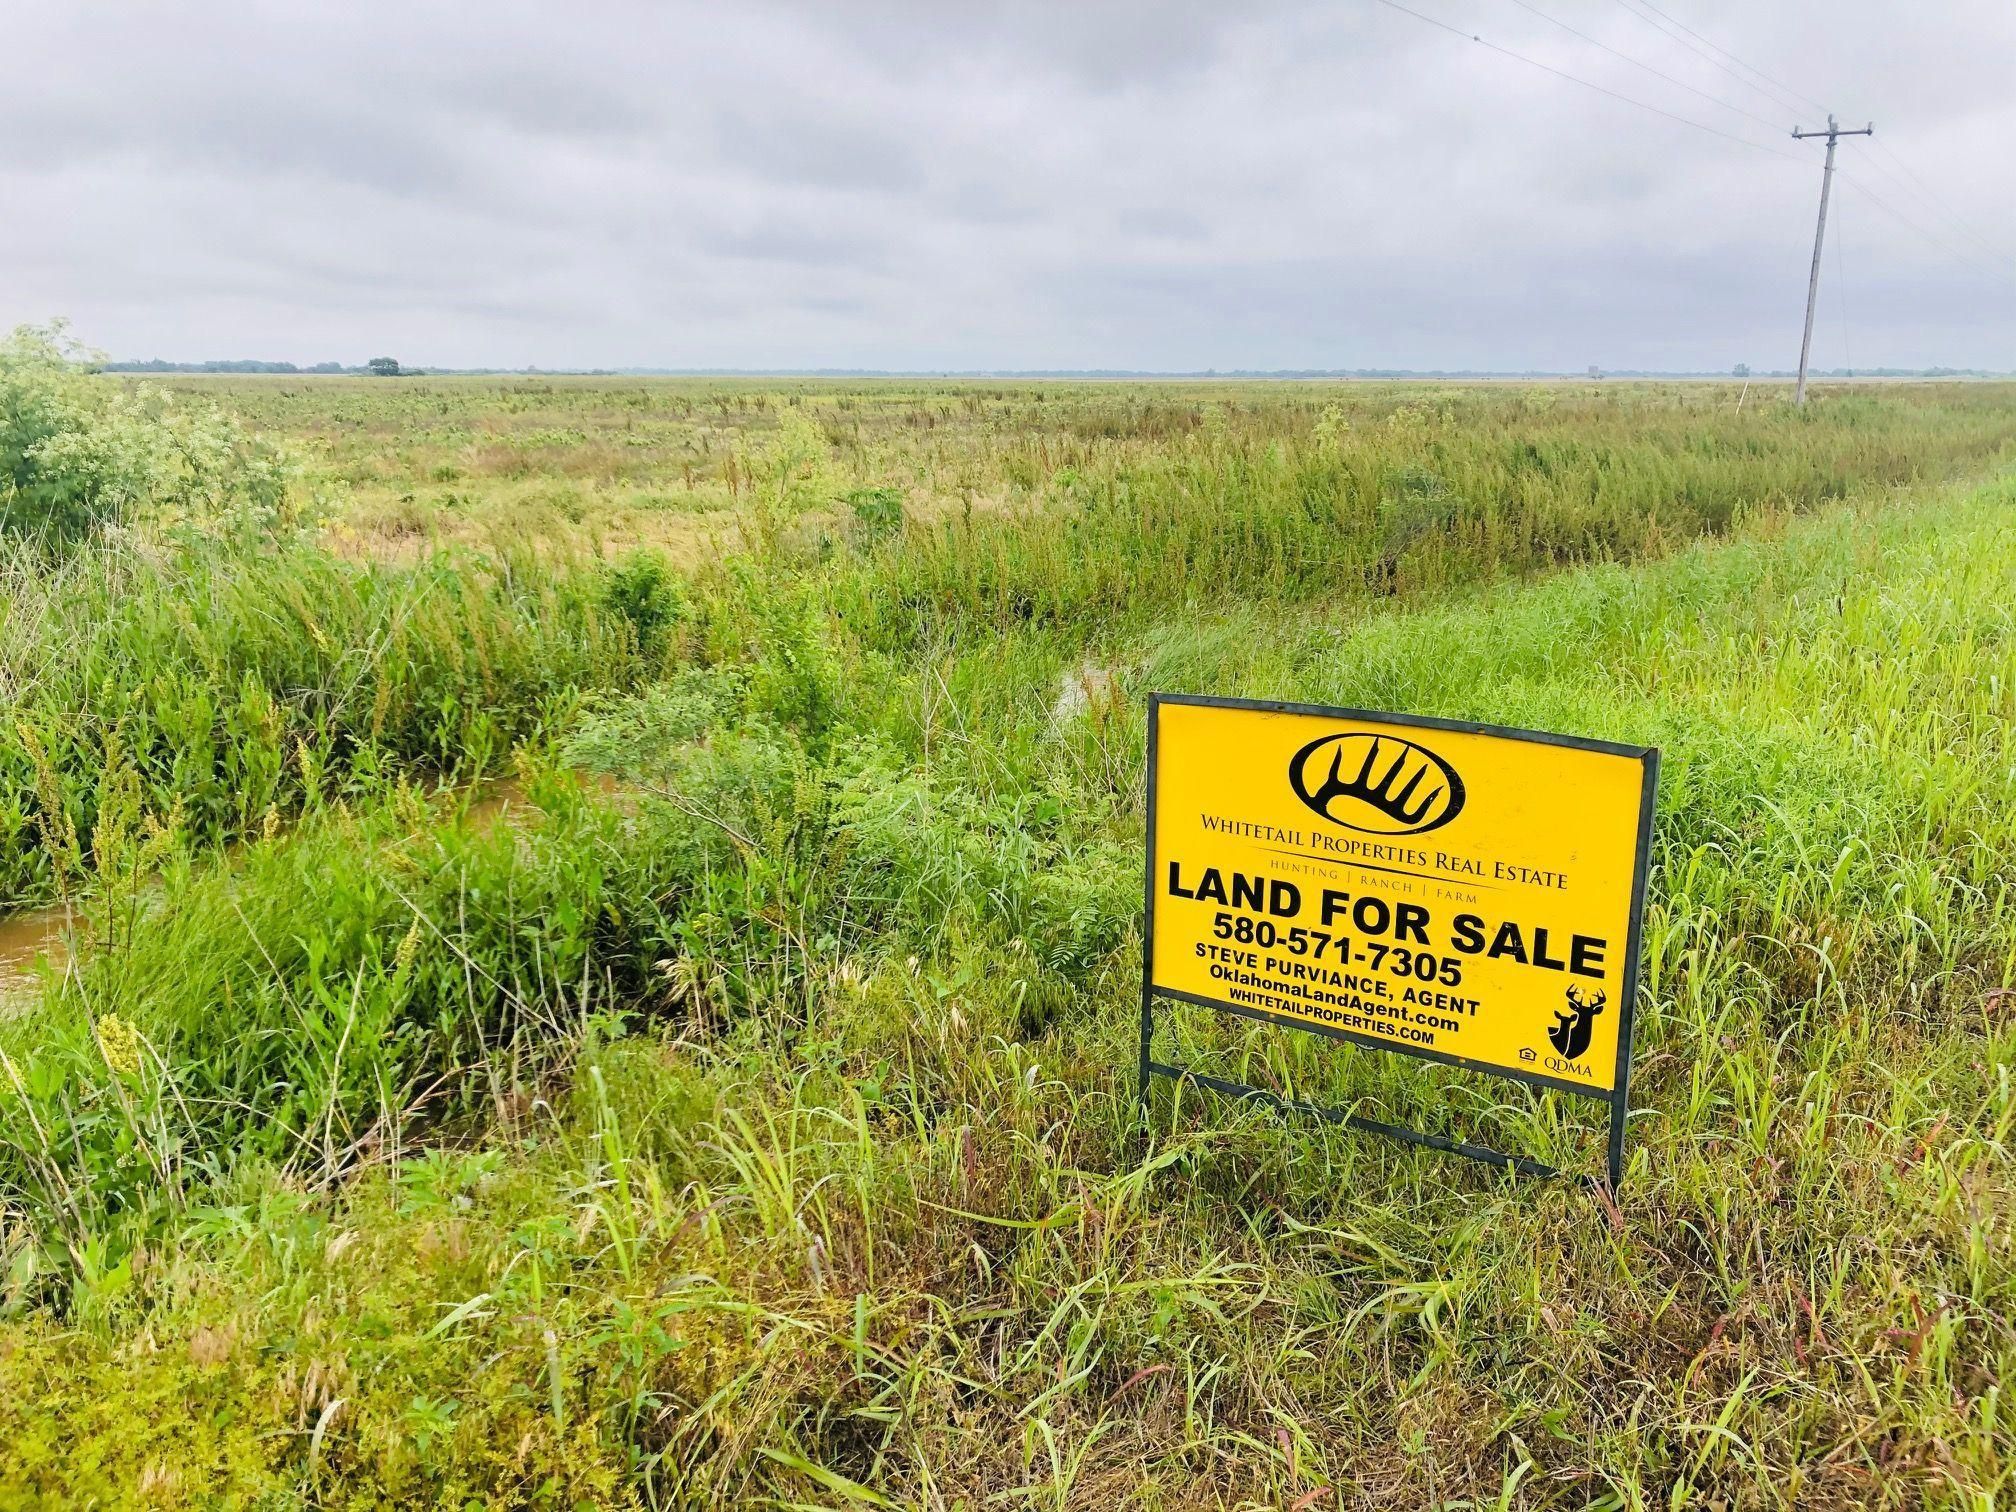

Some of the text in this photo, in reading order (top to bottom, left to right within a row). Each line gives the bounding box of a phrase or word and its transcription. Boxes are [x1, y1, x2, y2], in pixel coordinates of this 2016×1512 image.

[1271, 860, 1477, 904] HUNTING RANCH FARM
[1169, 862, 1607, 978] LAND FOR SALE
[1214, 912, 1462, 986] 580-571-7305
[1196, 943, 1480, 1016] STEVE PURVIANCE, AGENT
[1210, 965, 1459, 1032] OklahomaLandAgent.com
[1229, 987, 1434, 1044] WHITETAILPROPERTIES.COM
[1545, 1057, 1592, 1077] QDMA
